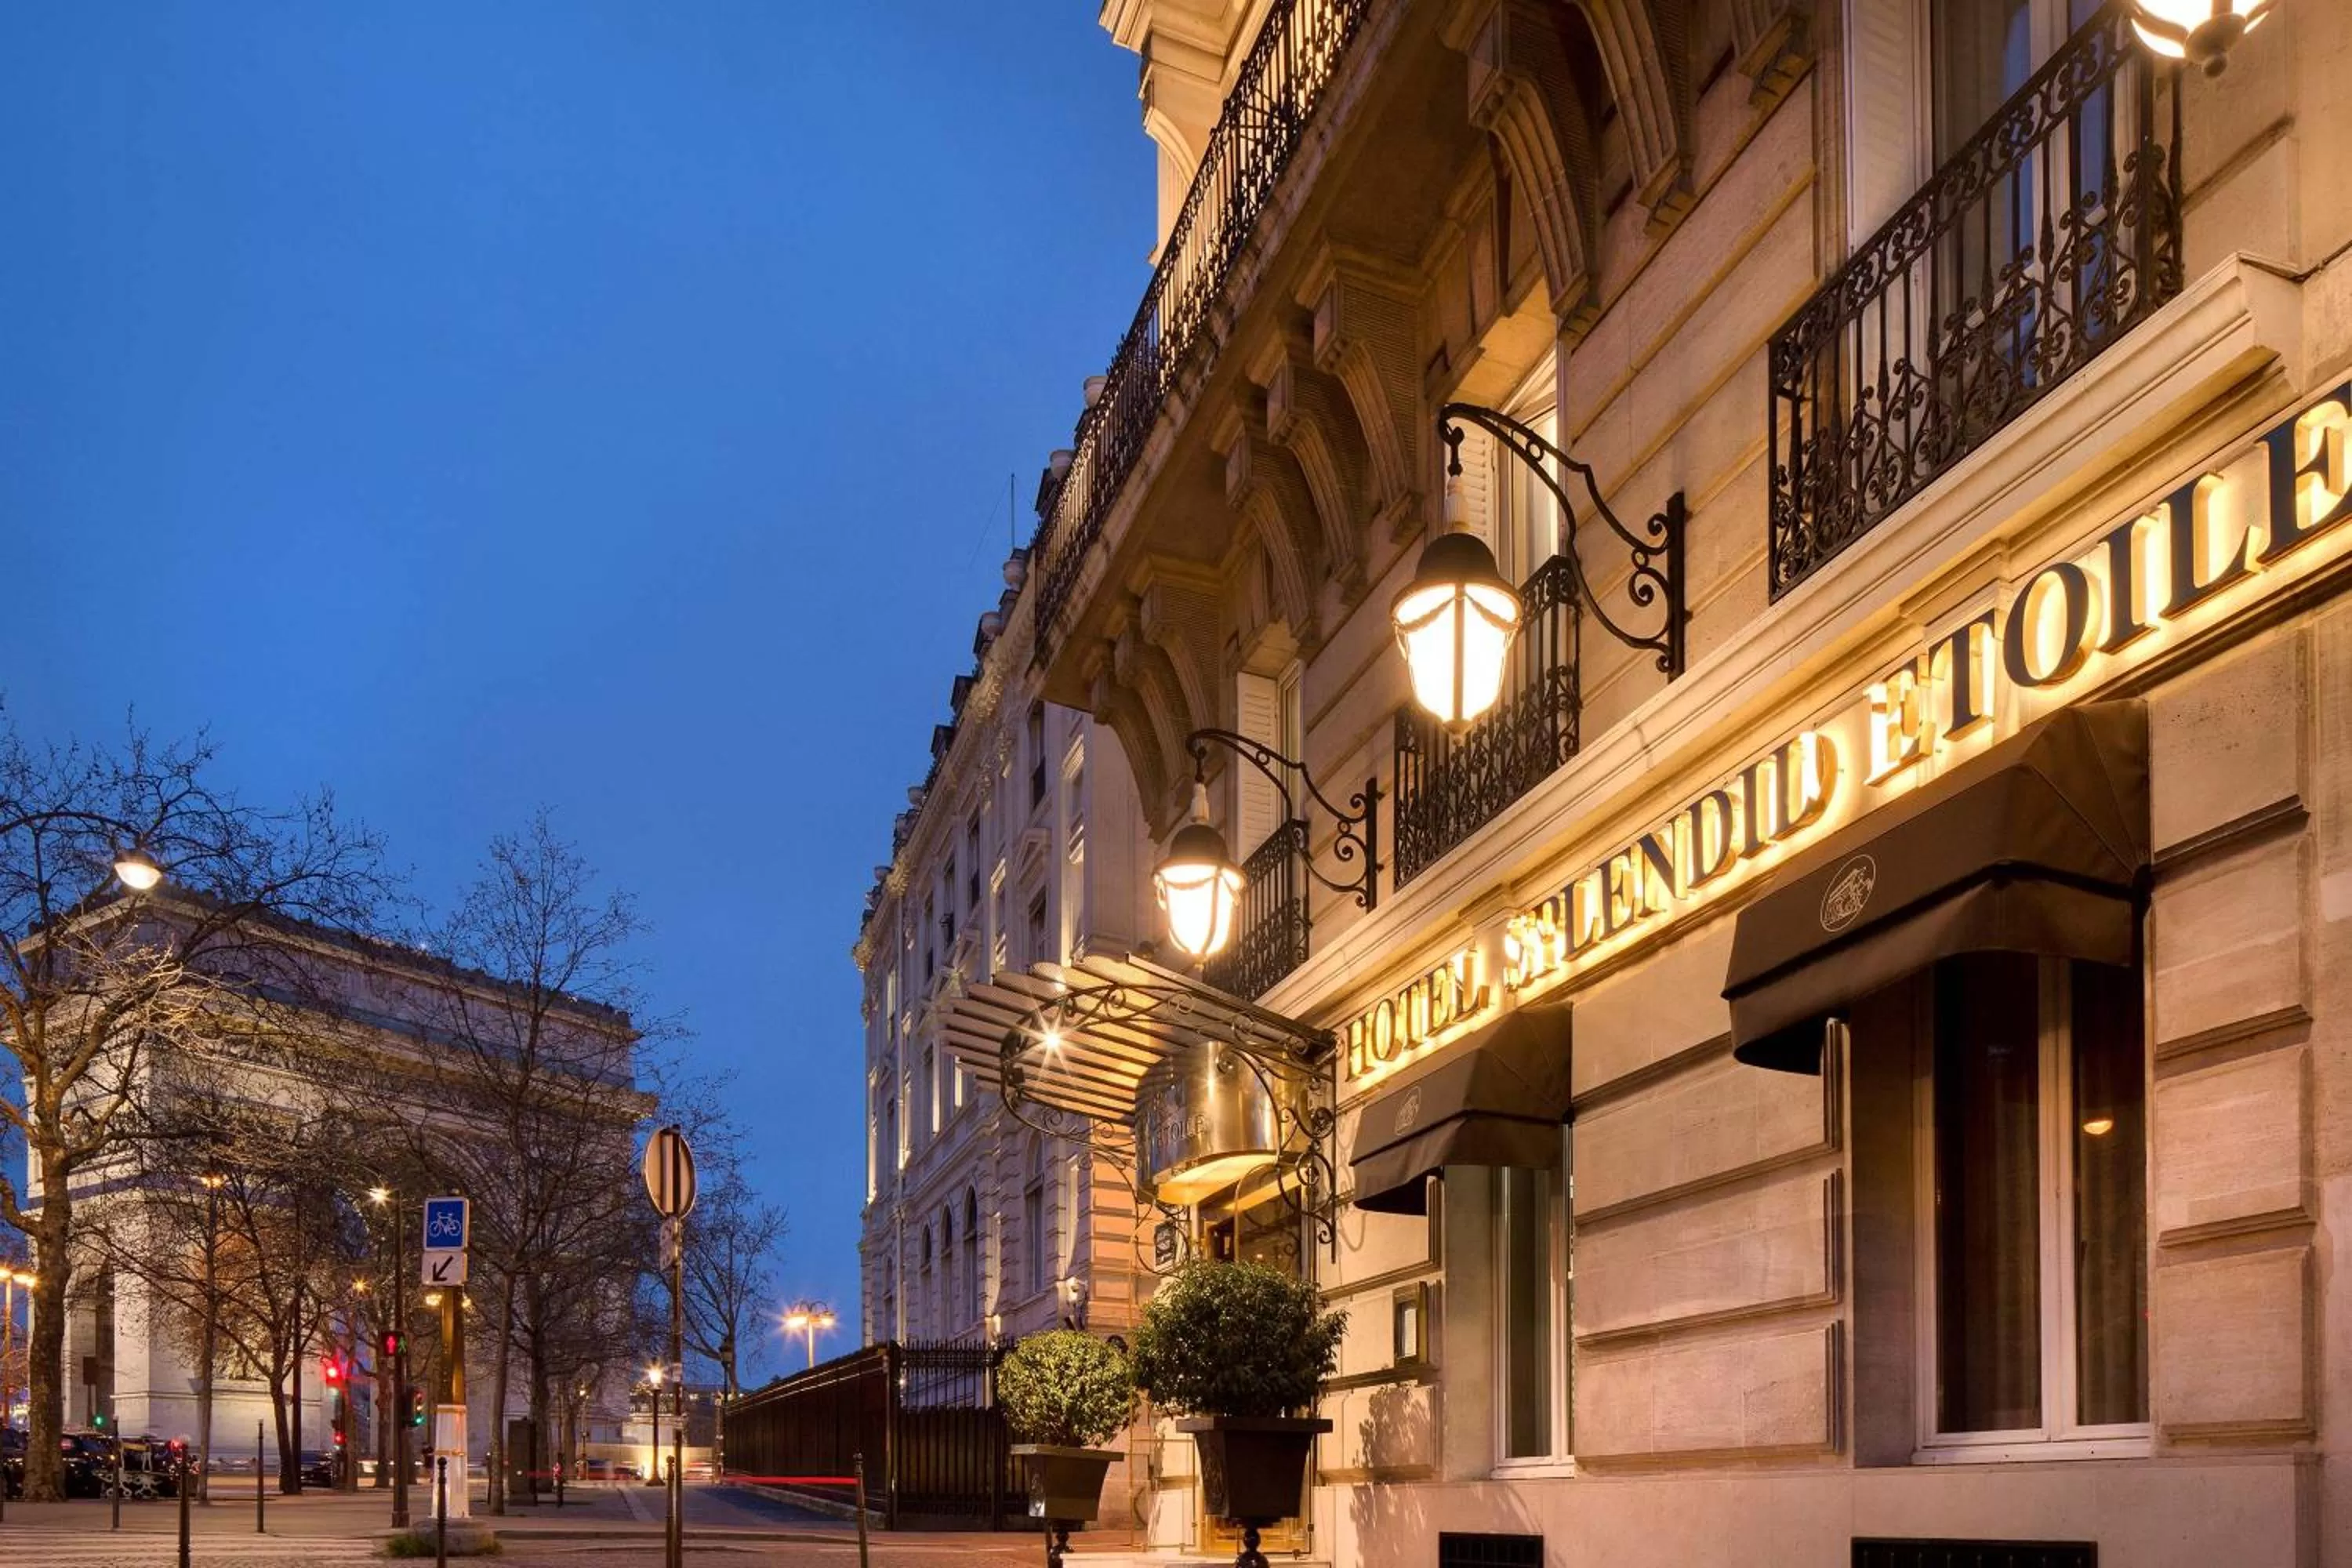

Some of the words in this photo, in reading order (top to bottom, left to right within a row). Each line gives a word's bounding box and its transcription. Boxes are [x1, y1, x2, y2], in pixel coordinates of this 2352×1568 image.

[1345, 949, 1489, 1082] HOTEL
[1504, 731, 1838, 989] SPLENDID
[1863, 381, 2352, 786] ETOILE
